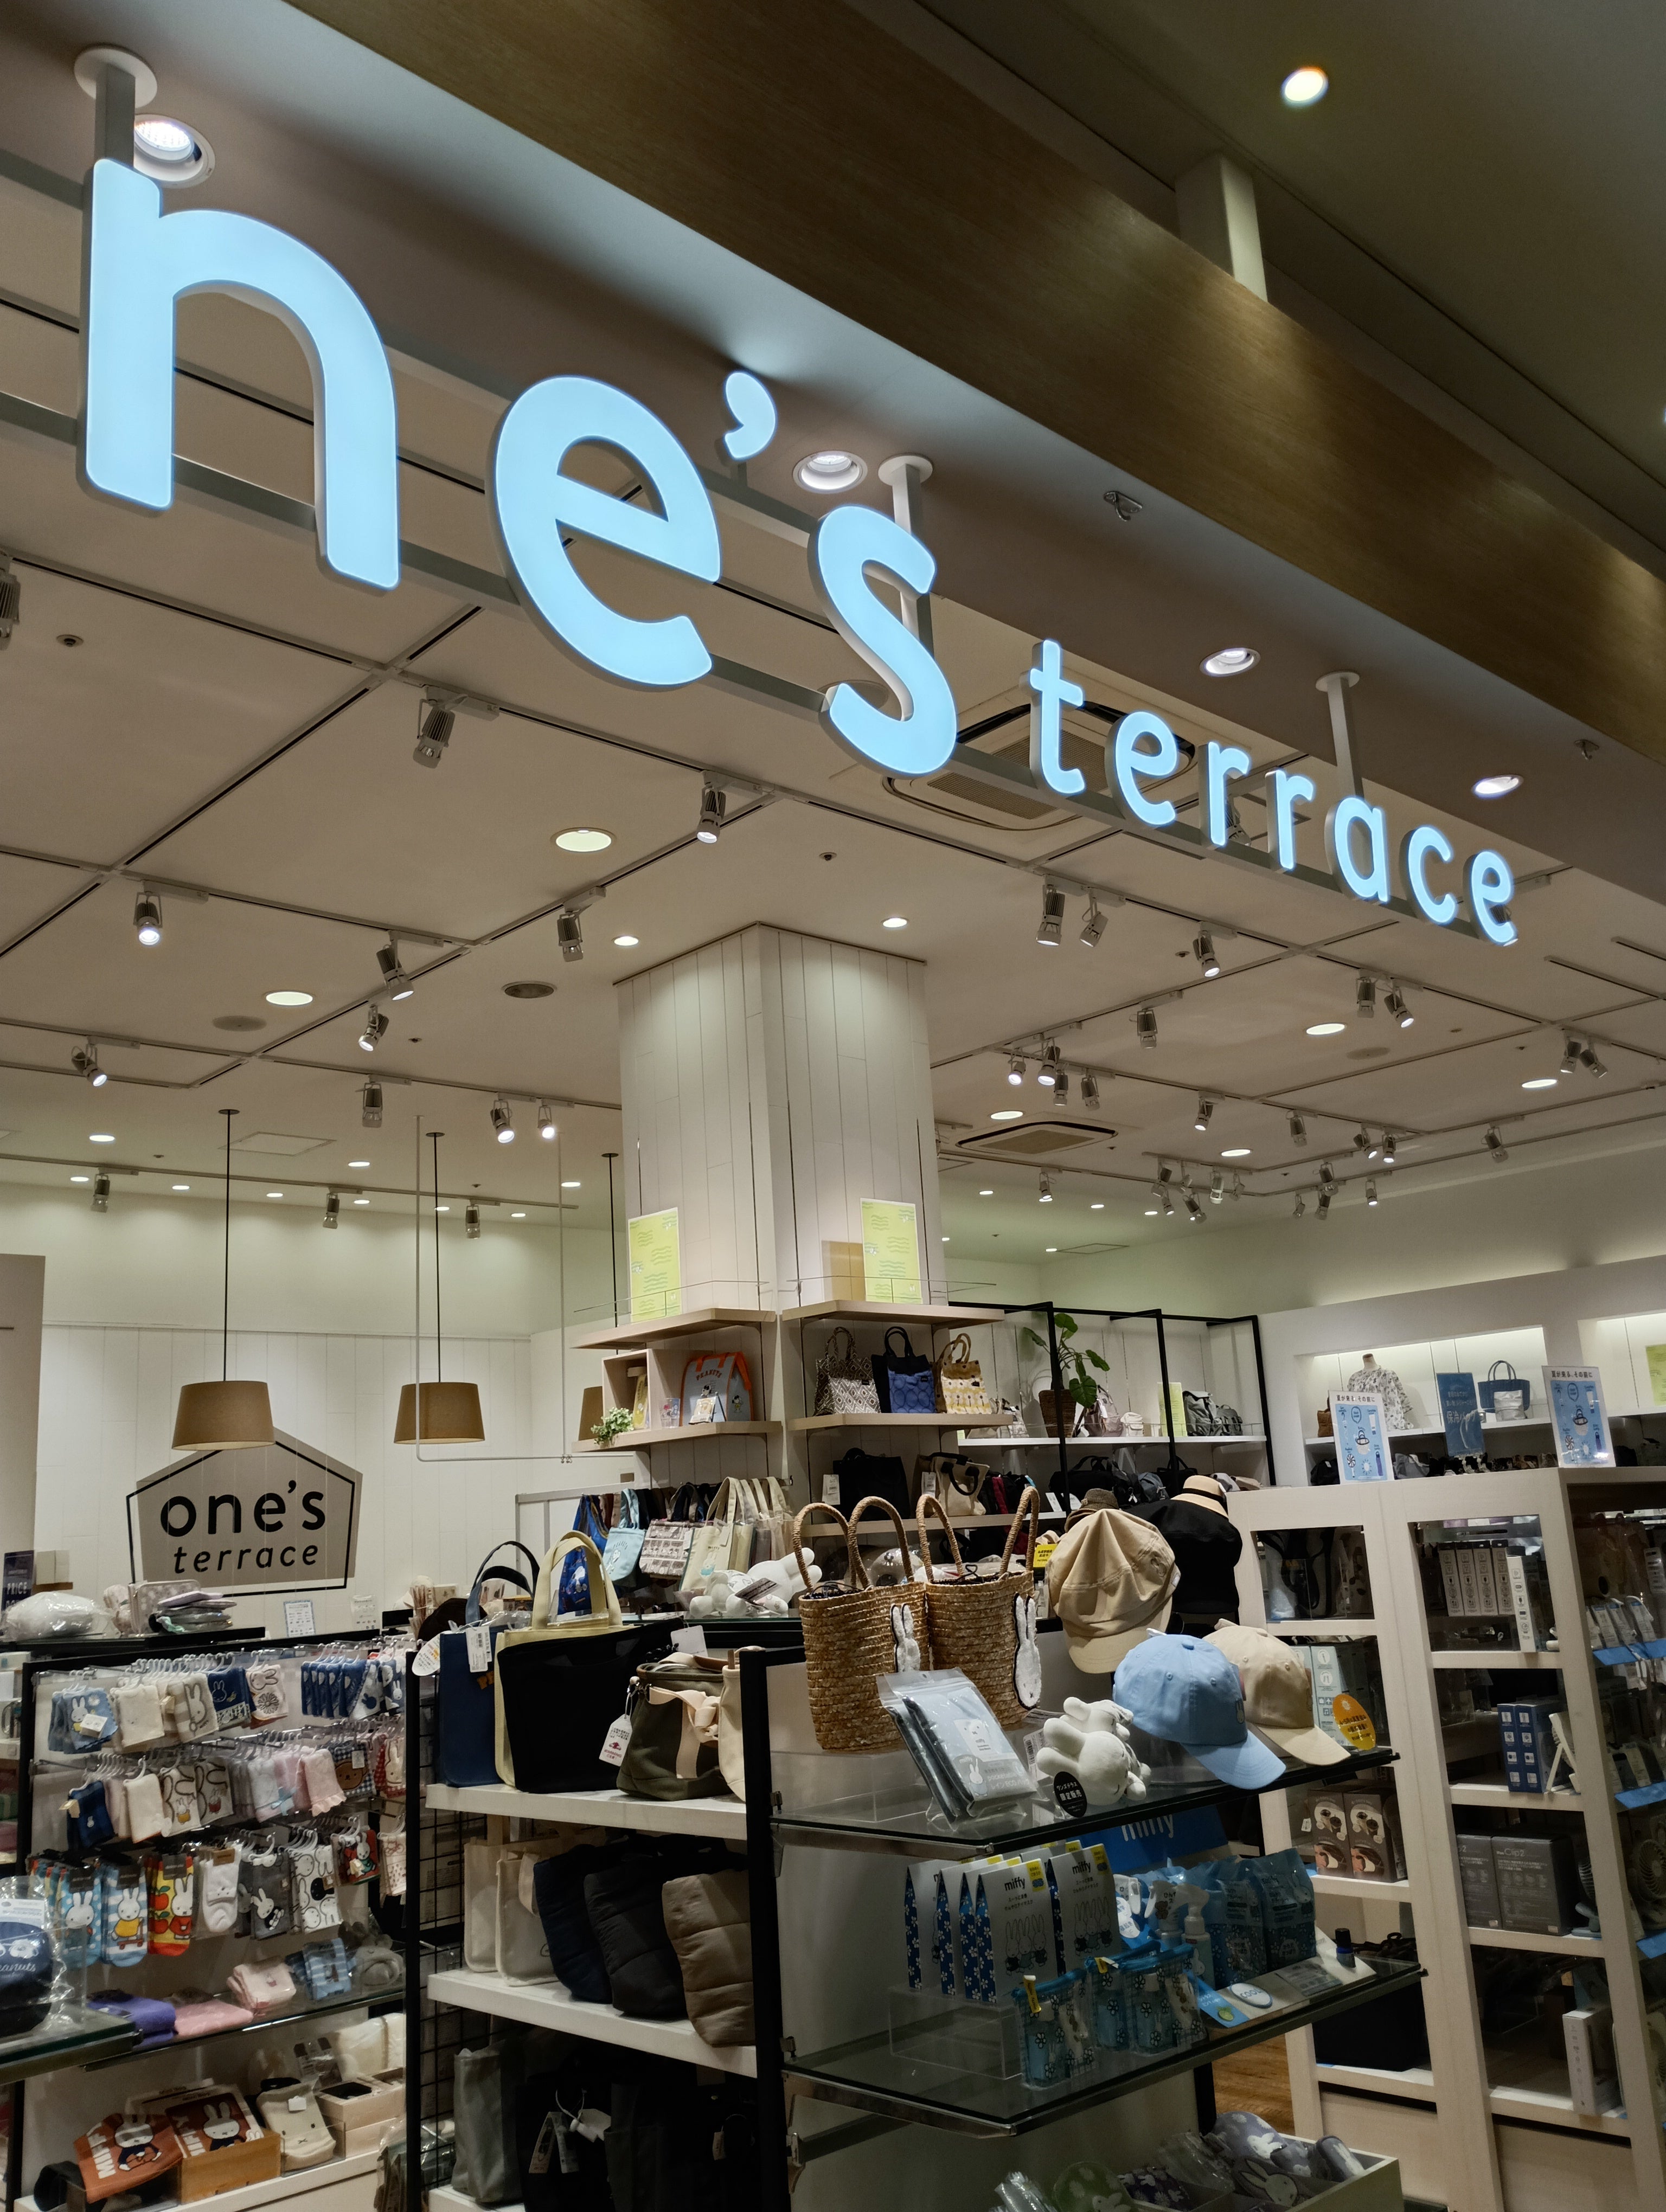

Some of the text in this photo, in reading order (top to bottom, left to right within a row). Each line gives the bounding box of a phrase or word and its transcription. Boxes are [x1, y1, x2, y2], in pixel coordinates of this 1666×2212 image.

[84, 158, 1518, 946] ne's terrace
[696, 1369, 722, 1381] PEANUTS
[160, 1480, 325, 1537] one's
[174, 1544, 318, 1574] terrace
[1056, 1782, 1078, 1791] ワンズテラス
[1059, 1790, 1082, 1801] 限定販売
[1072, 1861, 1091, 1875] miffy
[1004, 1876, 1026, 1891] miffy
[0, 1962, 36, 1972] eanuts
[1240, 1988, 1263, 2000] COOL
[86, 2122, 117, 2179] MIFF
